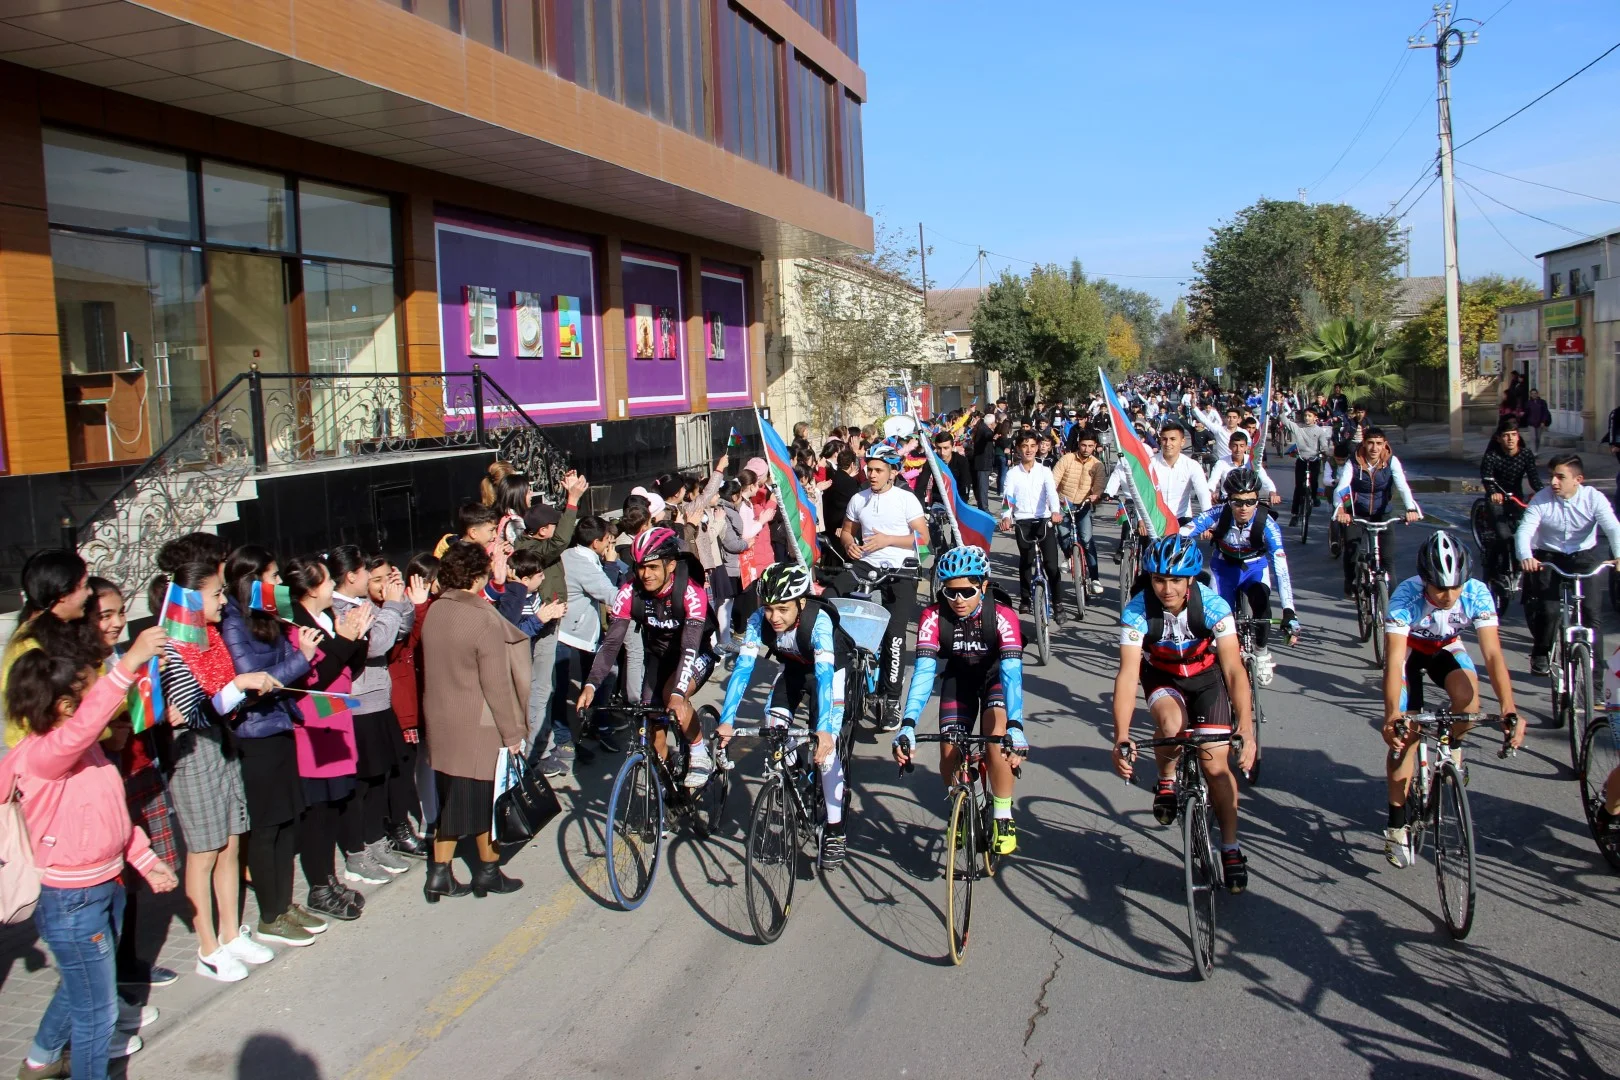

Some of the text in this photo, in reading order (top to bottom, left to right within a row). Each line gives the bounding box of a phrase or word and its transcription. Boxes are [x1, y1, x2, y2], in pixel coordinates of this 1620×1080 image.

[684, 586, 702, 616] AKU
[952, 640, 988, 651] BAKU
[676, 648, 697, 693] BAKU
